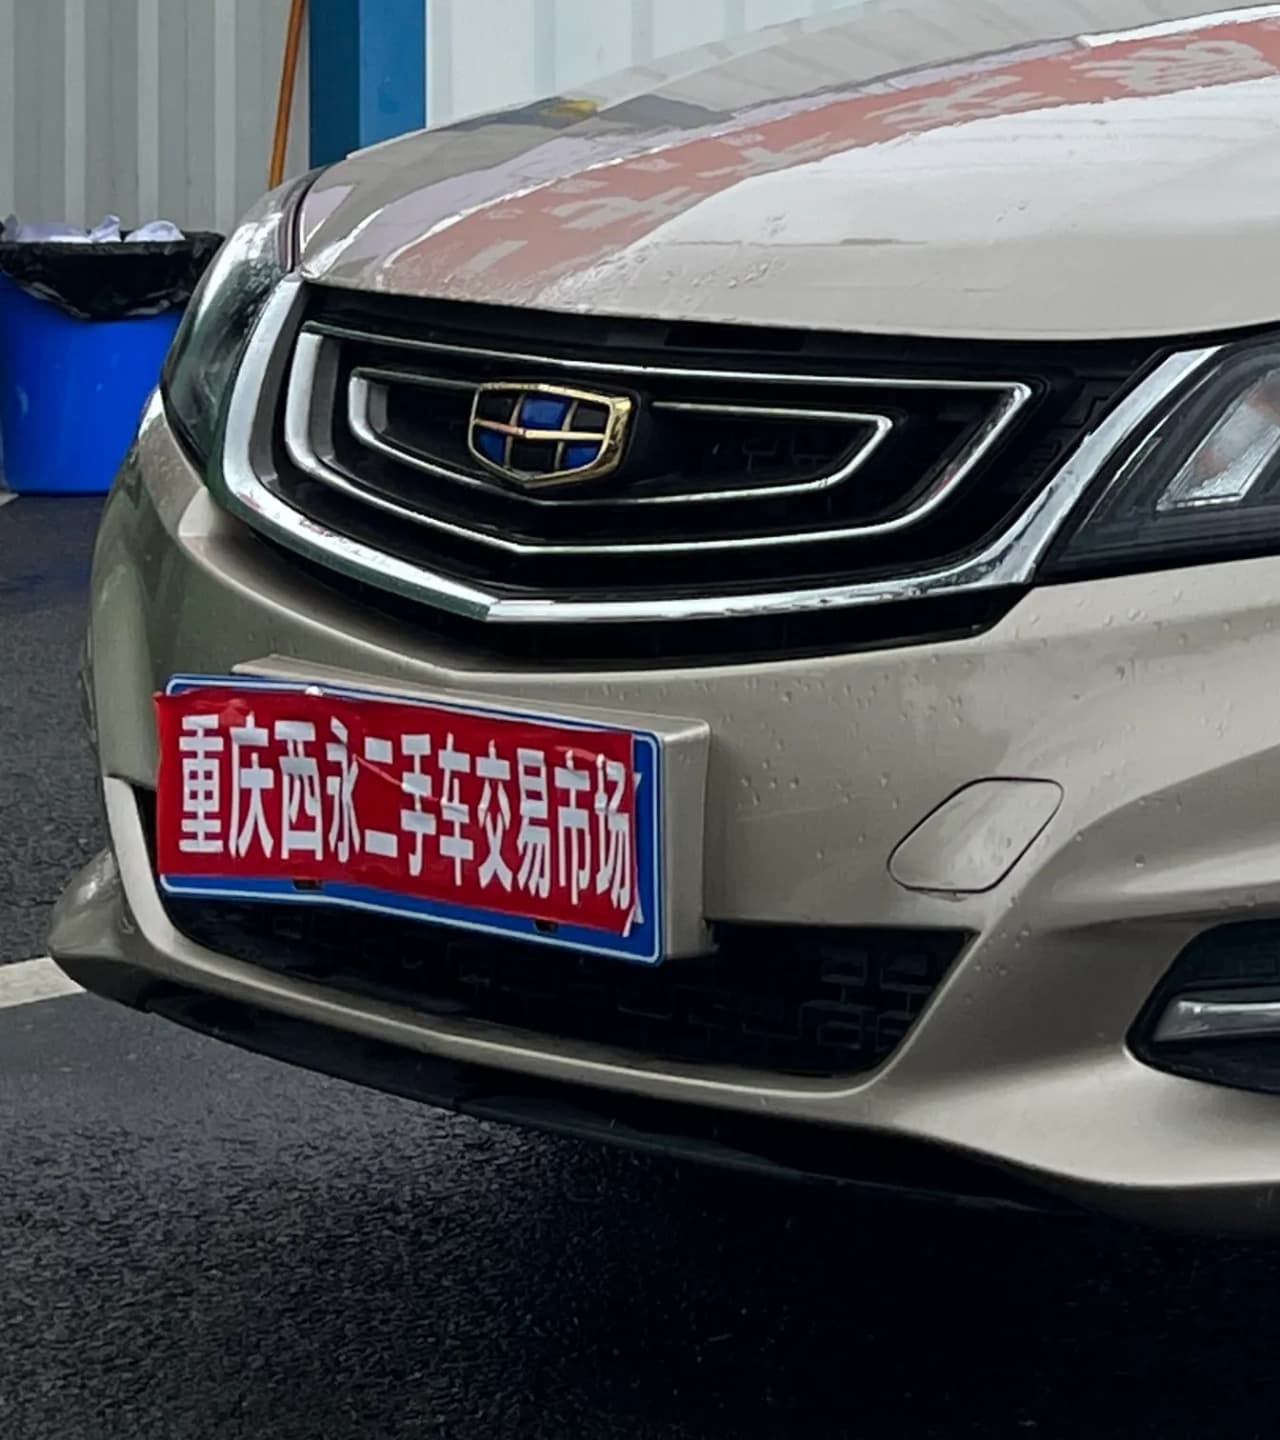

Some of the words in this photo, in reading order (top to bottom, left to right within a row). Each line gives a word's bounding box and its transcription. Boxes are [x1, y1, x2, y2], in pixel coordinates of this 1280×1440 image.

[178, 711, 632, 910] 重庆西永二手车交易市场
